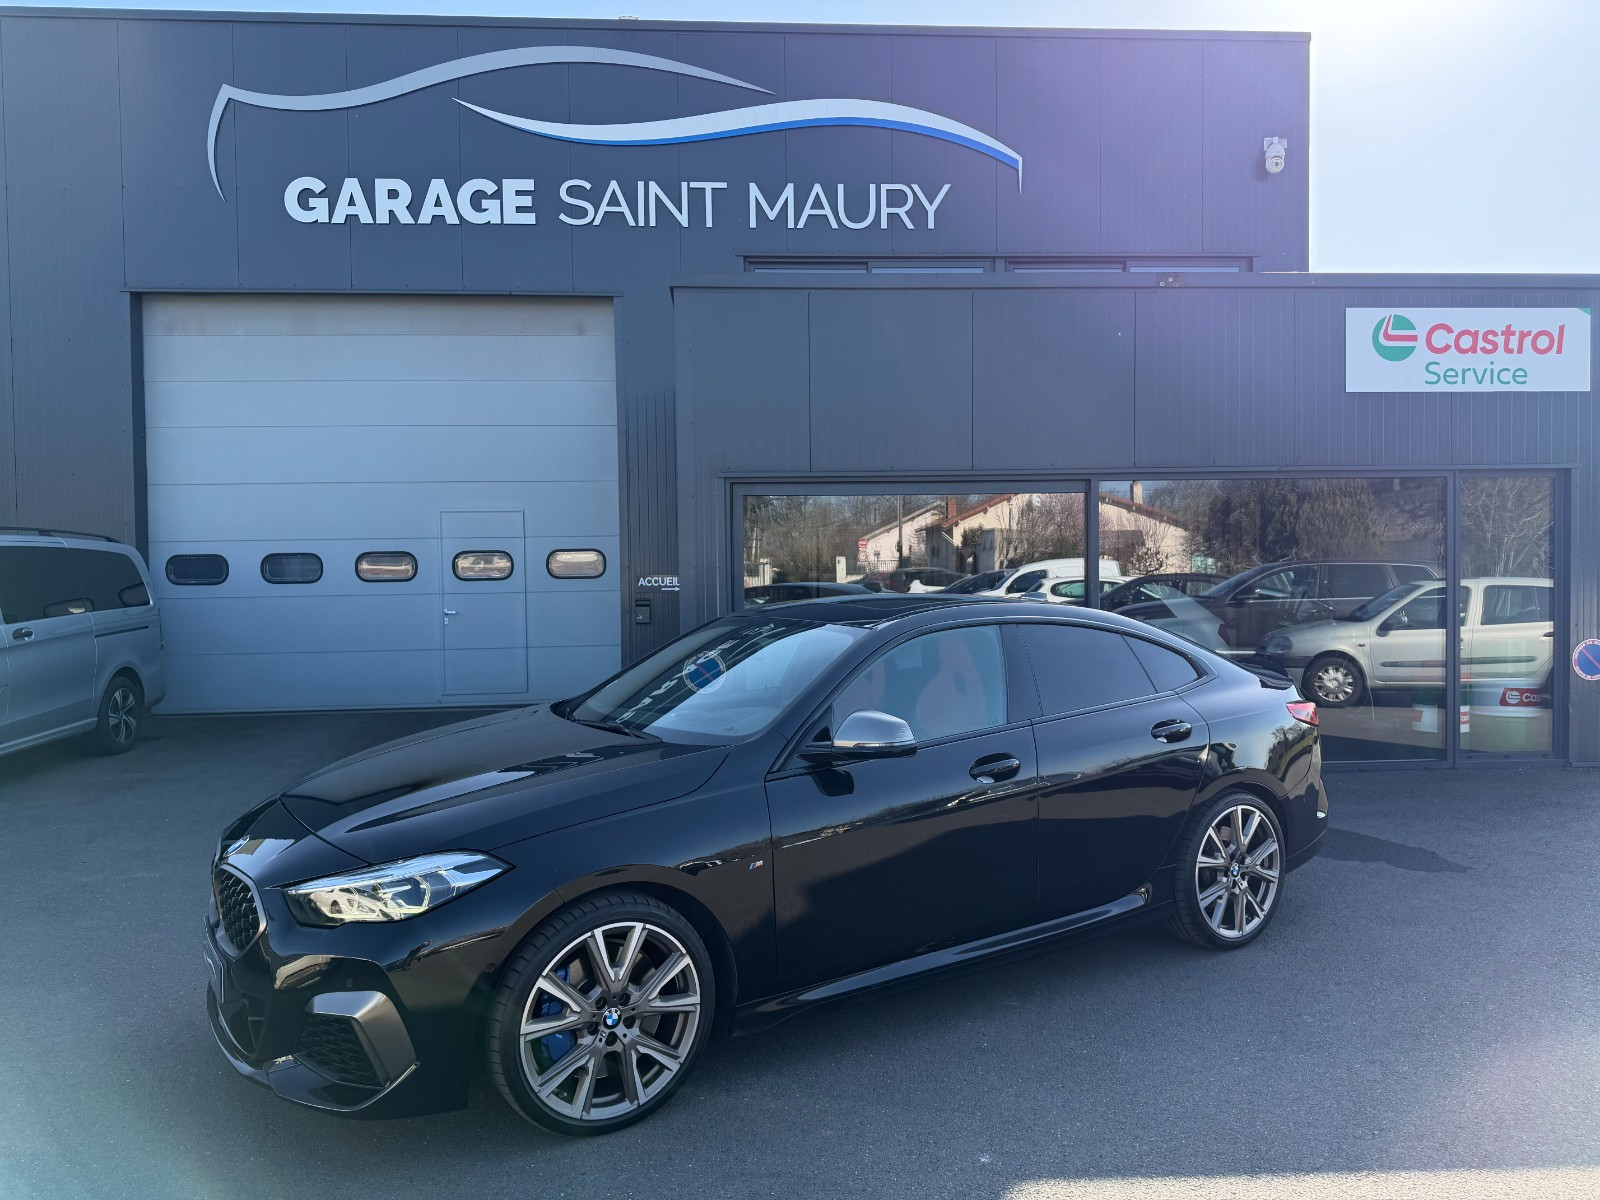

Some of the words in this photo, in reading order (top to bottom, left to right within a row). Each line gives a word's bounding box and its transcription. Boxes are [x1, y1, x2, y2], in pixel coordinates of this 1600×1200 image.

[284, 176, 537, 225] GARAGE
[558, 178, 728, 228] SAINT
[748, 182, 952, 230] MAURY
[1425, 323, 1566, 355] Castrol
[1424, 361, 1528, 385] Service
[638, 576, 680, 587] ACCUEIL
